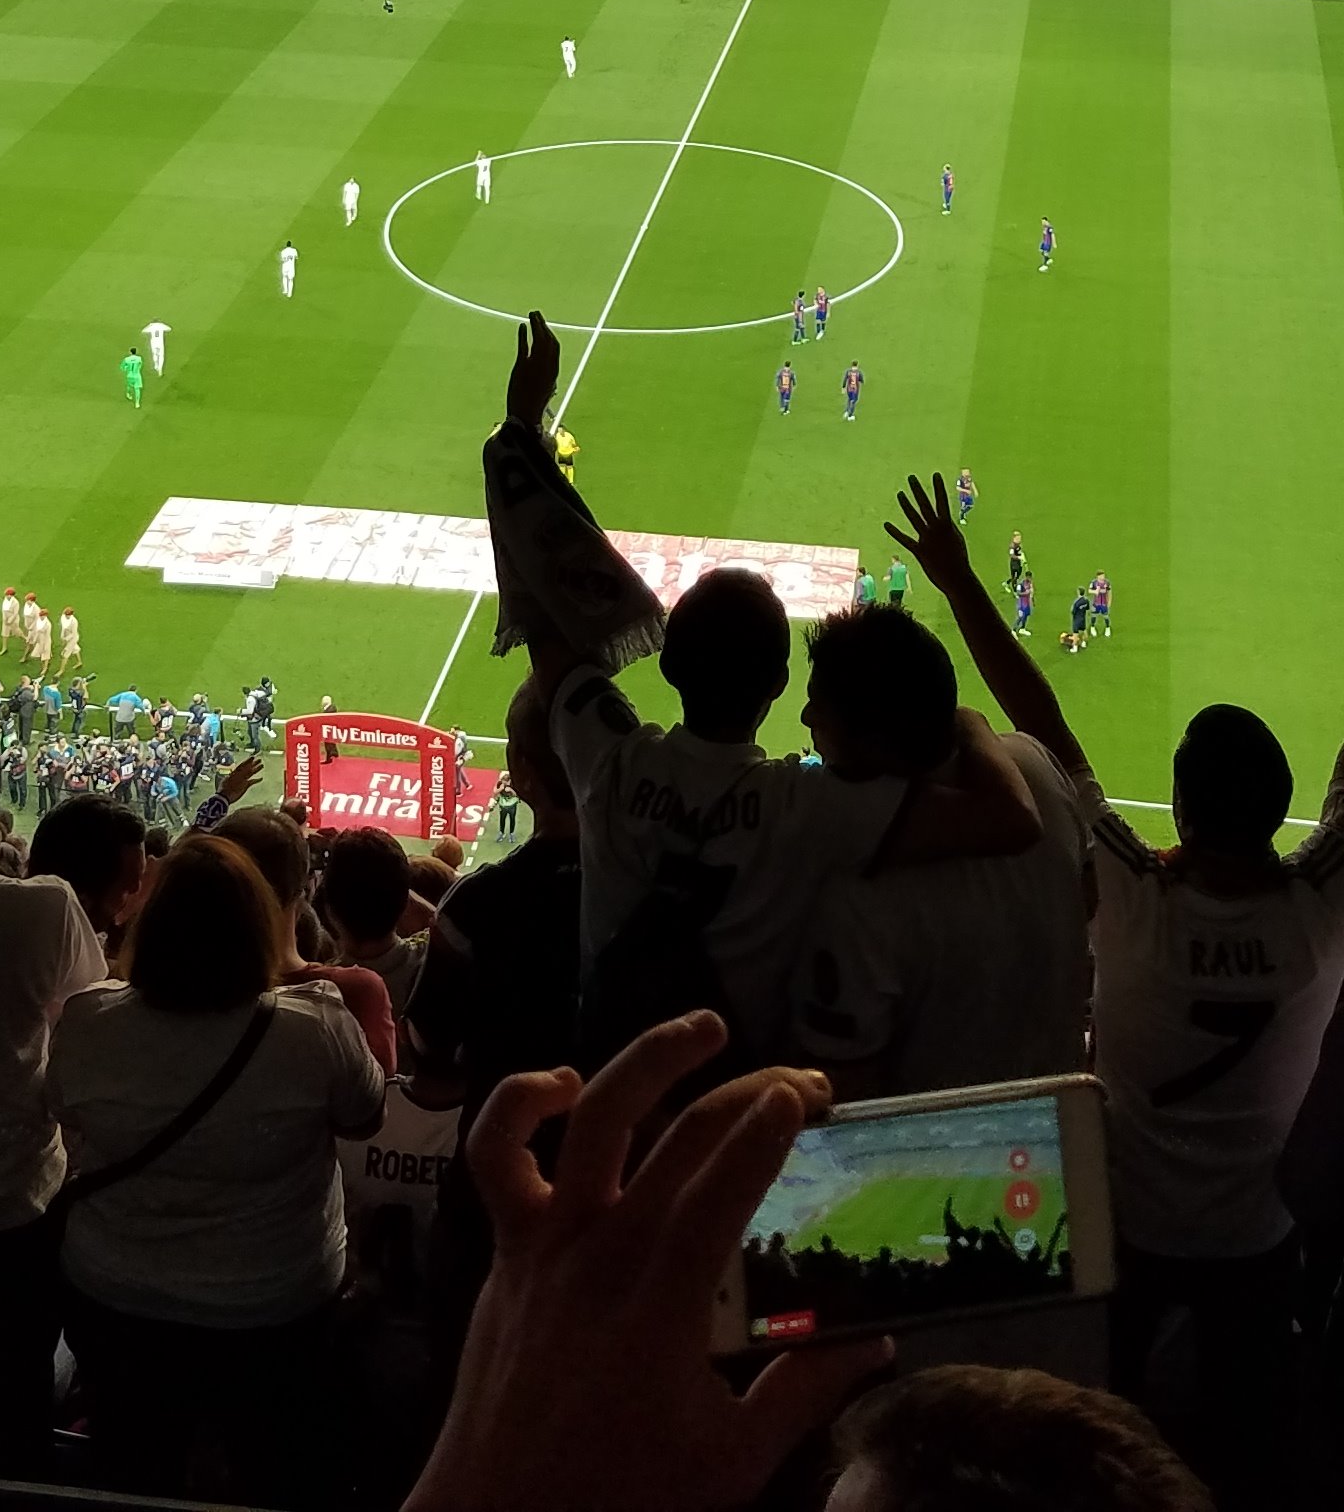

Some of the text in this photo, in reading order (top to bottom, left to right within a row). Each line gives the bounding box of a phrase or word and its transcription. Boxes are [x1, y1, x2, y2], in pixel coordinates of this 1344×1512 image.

[321, 724, 418, 747] Fly Emirates
[368, 772, 423, 797] Fly
[429, 755, 444, 815] Emirates
[1152, 1001, 1276, 1109] 7
